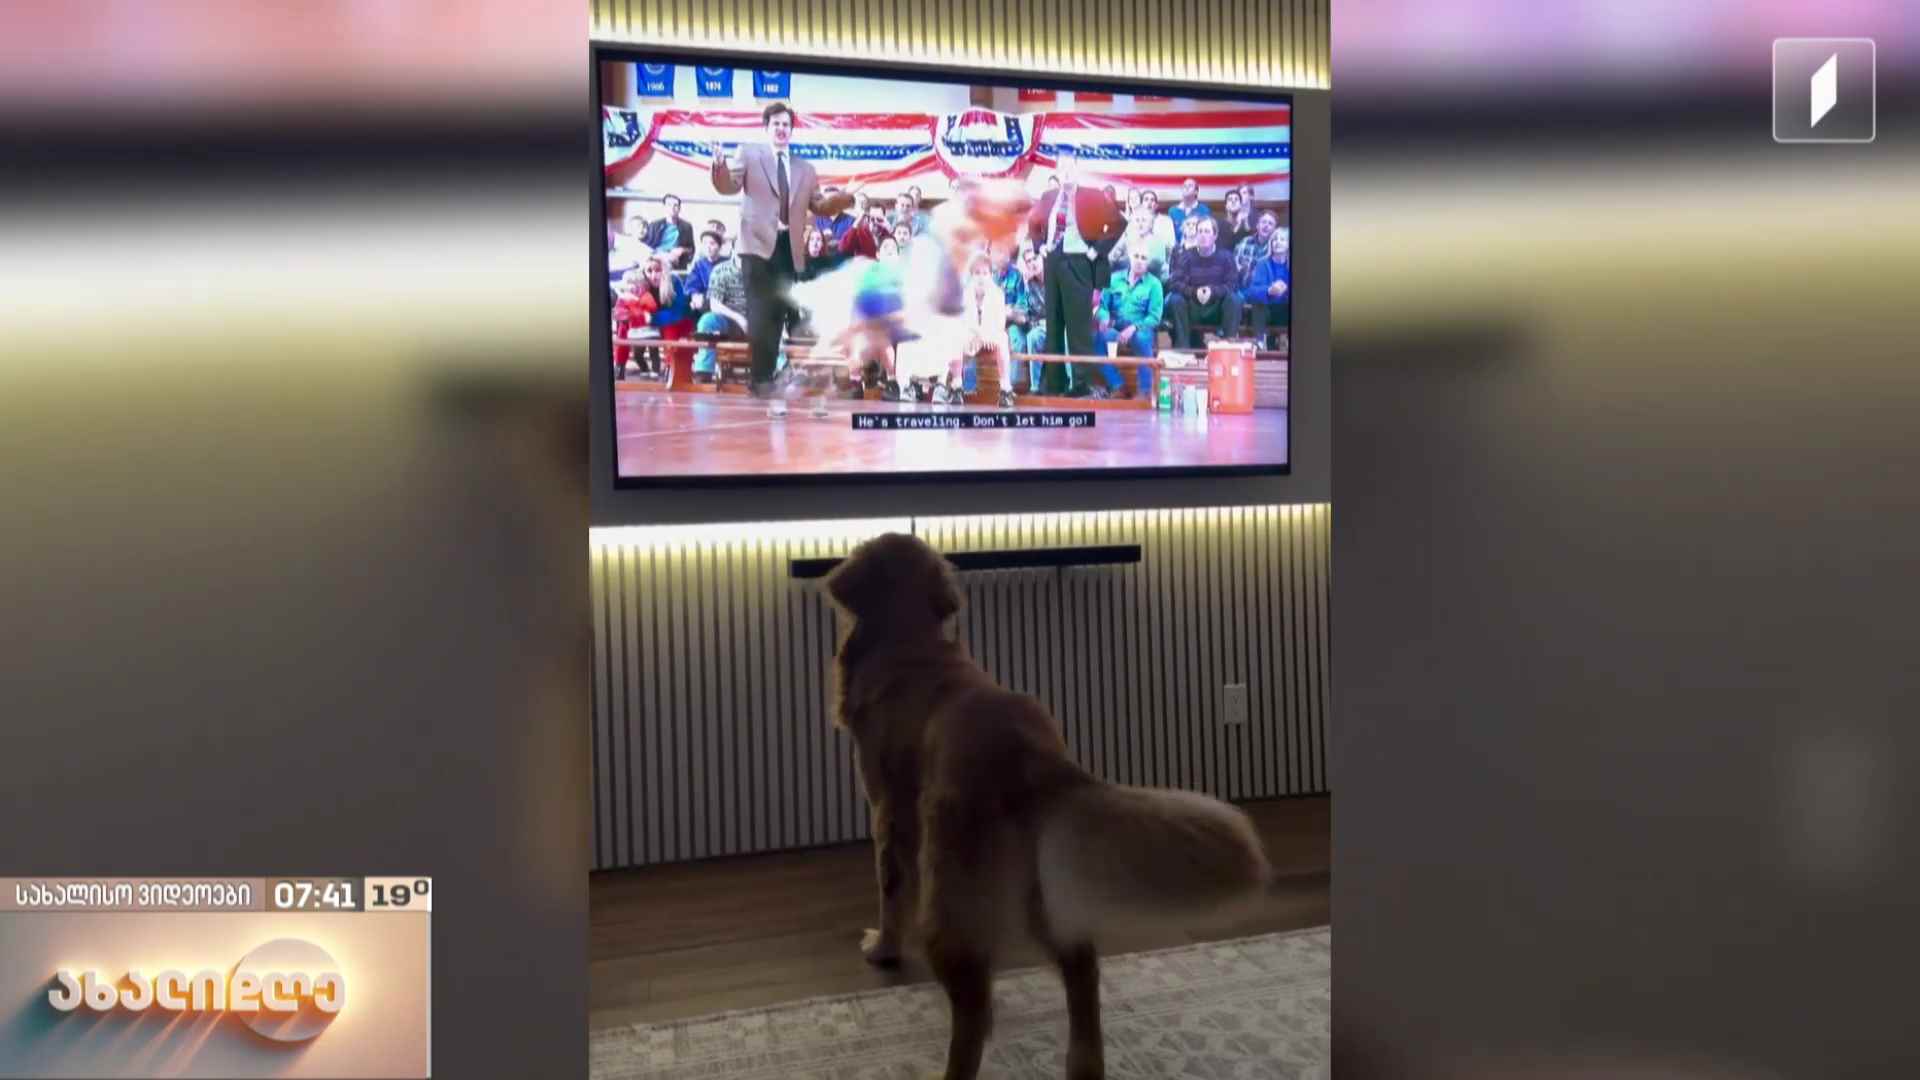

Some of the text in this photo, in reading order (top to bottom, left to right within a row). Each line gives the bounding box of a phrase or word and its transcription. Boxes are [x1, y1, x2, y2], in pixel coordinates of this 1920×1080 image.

[858, 414, 1088, 429] He's traveling. Don't let him go!
